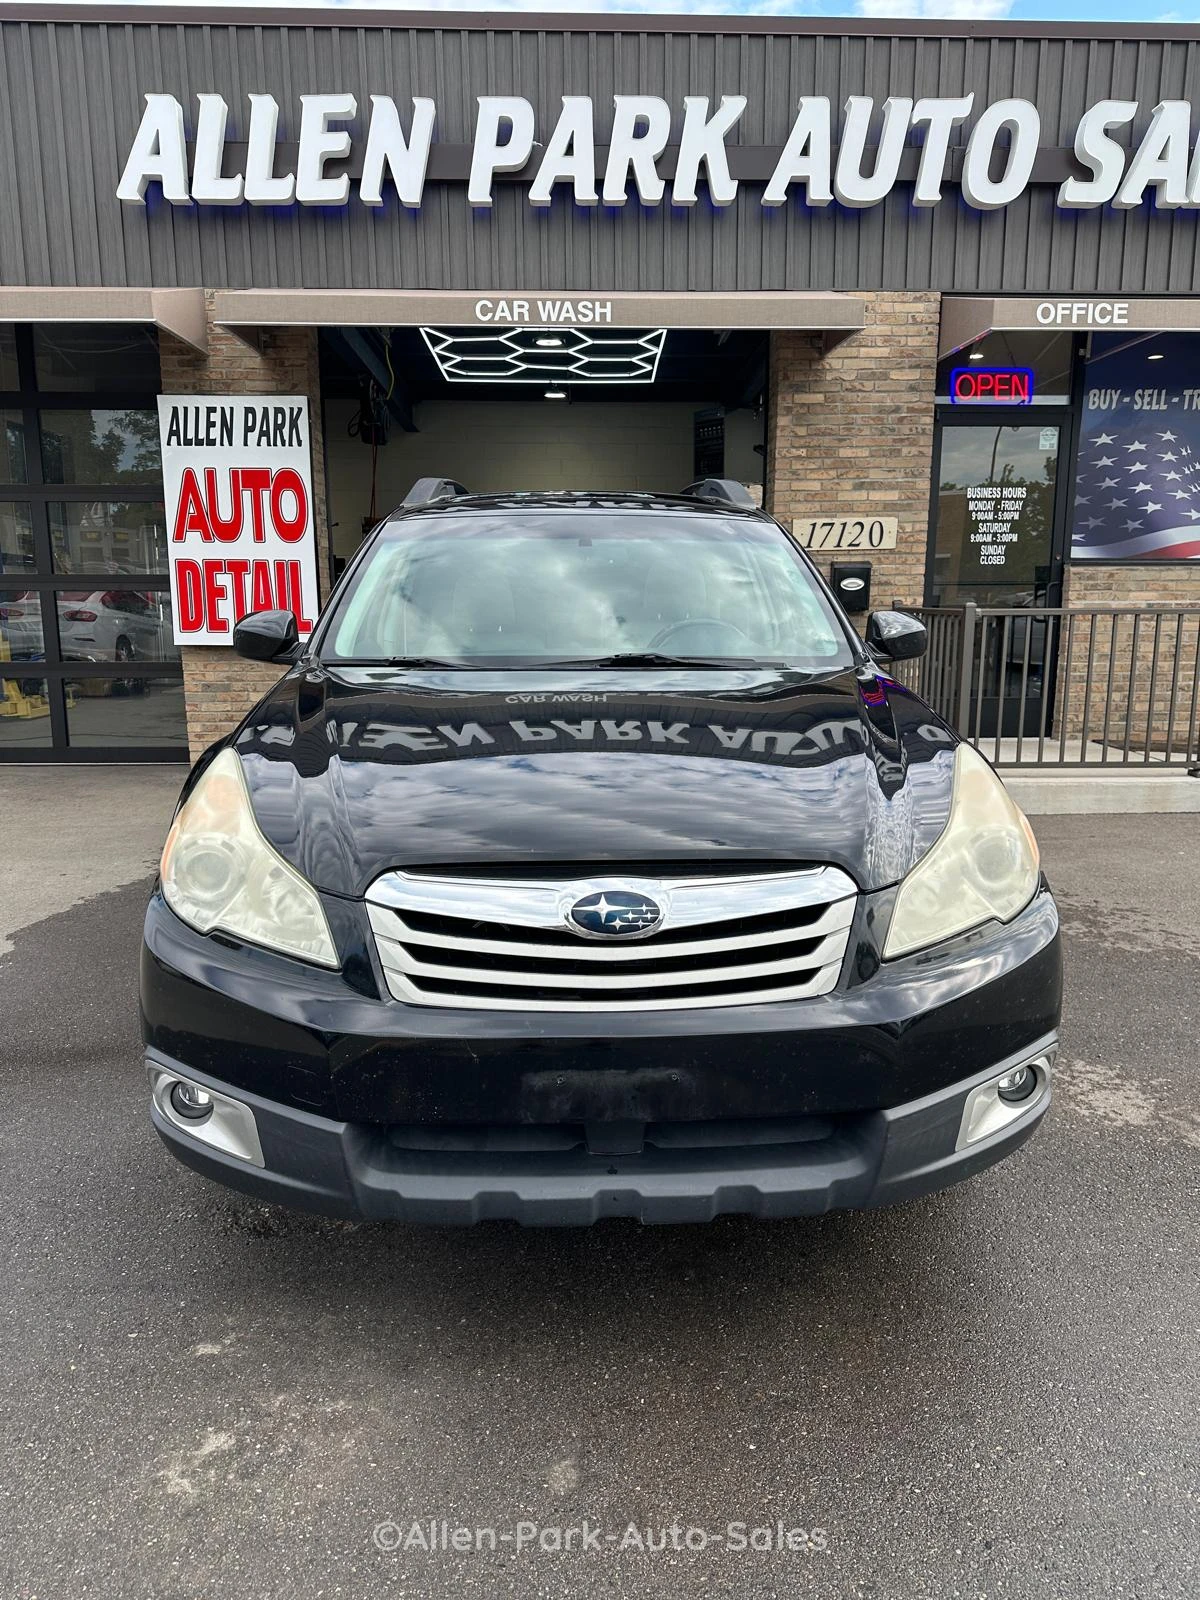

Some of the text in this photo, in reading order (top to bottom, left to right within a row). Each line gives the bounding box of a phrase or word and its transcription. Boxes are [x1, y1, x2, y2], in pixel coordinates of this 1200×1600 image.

[116, 93, 436, 207] ALLEN
[468, 95, 747, 207] PARK
[762, 92, 1041, 209] AUTO
[475, 300, 612, 322] CAR WASH
[1036, 302, 1128, 324] OFFICE
[955, 374, 1029, 400] OPEN
[1088, 389, 1121, 410] BUY
[1133, 389, 1168, 410] SELL
[166, 406, 303, 447] ALLEN PARK
[967, 487, 1027, 498] BUSINESS HOURS
[173, 467, 309, 543] AUTO
[968, 501, 995, 511] MONDAY
[1001, 501, 1023, 510] FRIDAY
[971, 511, 993, 520] 9:00AM
[998, 511, 1020, 520] 5:00PM
[804, 521, 884, 548] 17120
[970, 534, 992, 542] 9:00AM
[996, 534, 1018, 542] 3:00PM
[978, 523, 1011, 533] SATURDAY
[980, 545, 1006, 555] SUNDAY
[980, 556, 1005, 564] CLOSED
[175, 559, 313, 634] DETAIL
